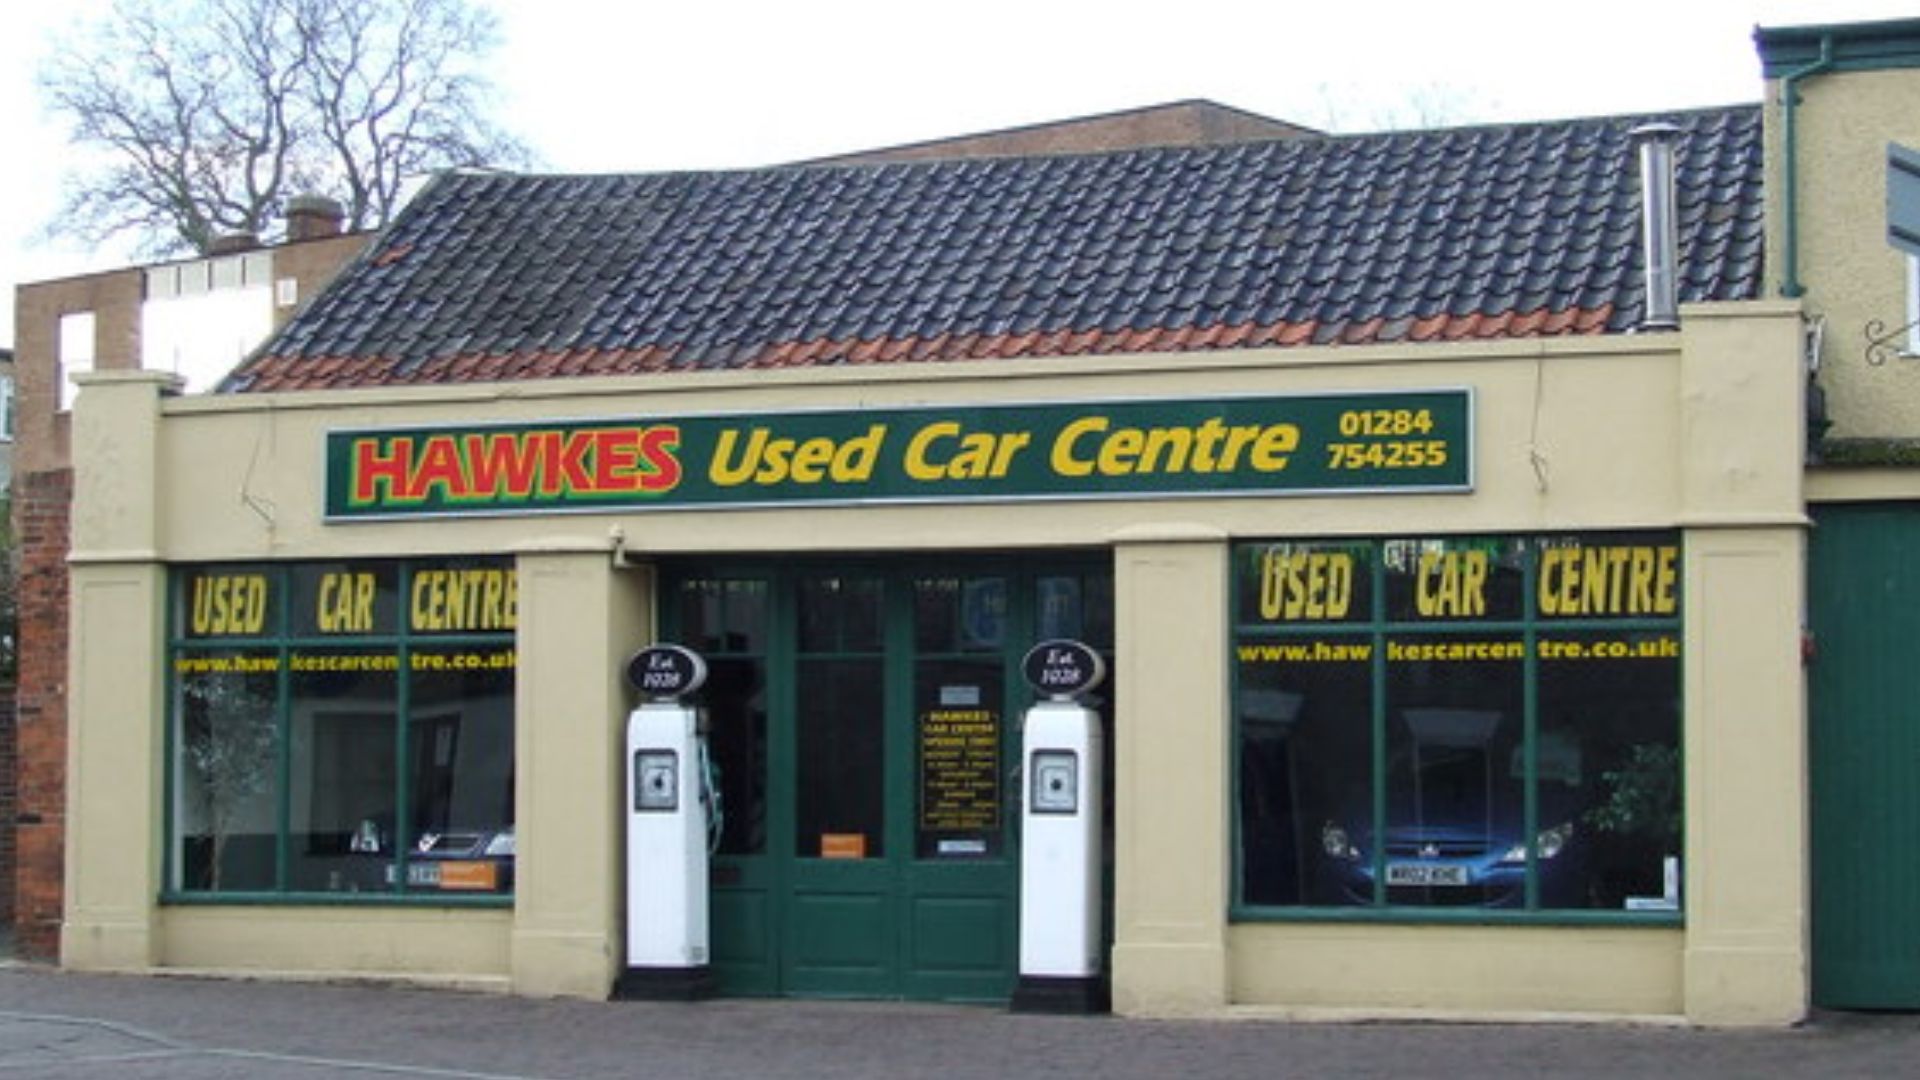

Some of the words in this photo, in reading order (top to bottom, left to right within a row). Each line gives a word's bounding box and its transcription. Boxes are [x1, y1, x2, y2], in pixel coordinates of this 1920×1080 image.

[1326, 440, 1448, 470] 754255
[1338, 409, 1434, 437] 01284
[350, 425, 682, 507] HAWKES
[708, 424, 888, 487] Used
[903, 420, 1031, 481] Car
[1050, 416, 1300, 477] Centre
[192, 575, 267, 634] USED
[317, 572, 376, 632] CAR
[411, 569, 518, 631] CENTRE
[1260, 552, 1353, 620] USED
[1415, 549, 1488, 617] CAR
[1538, 545, 1678, 616] CENTRE
